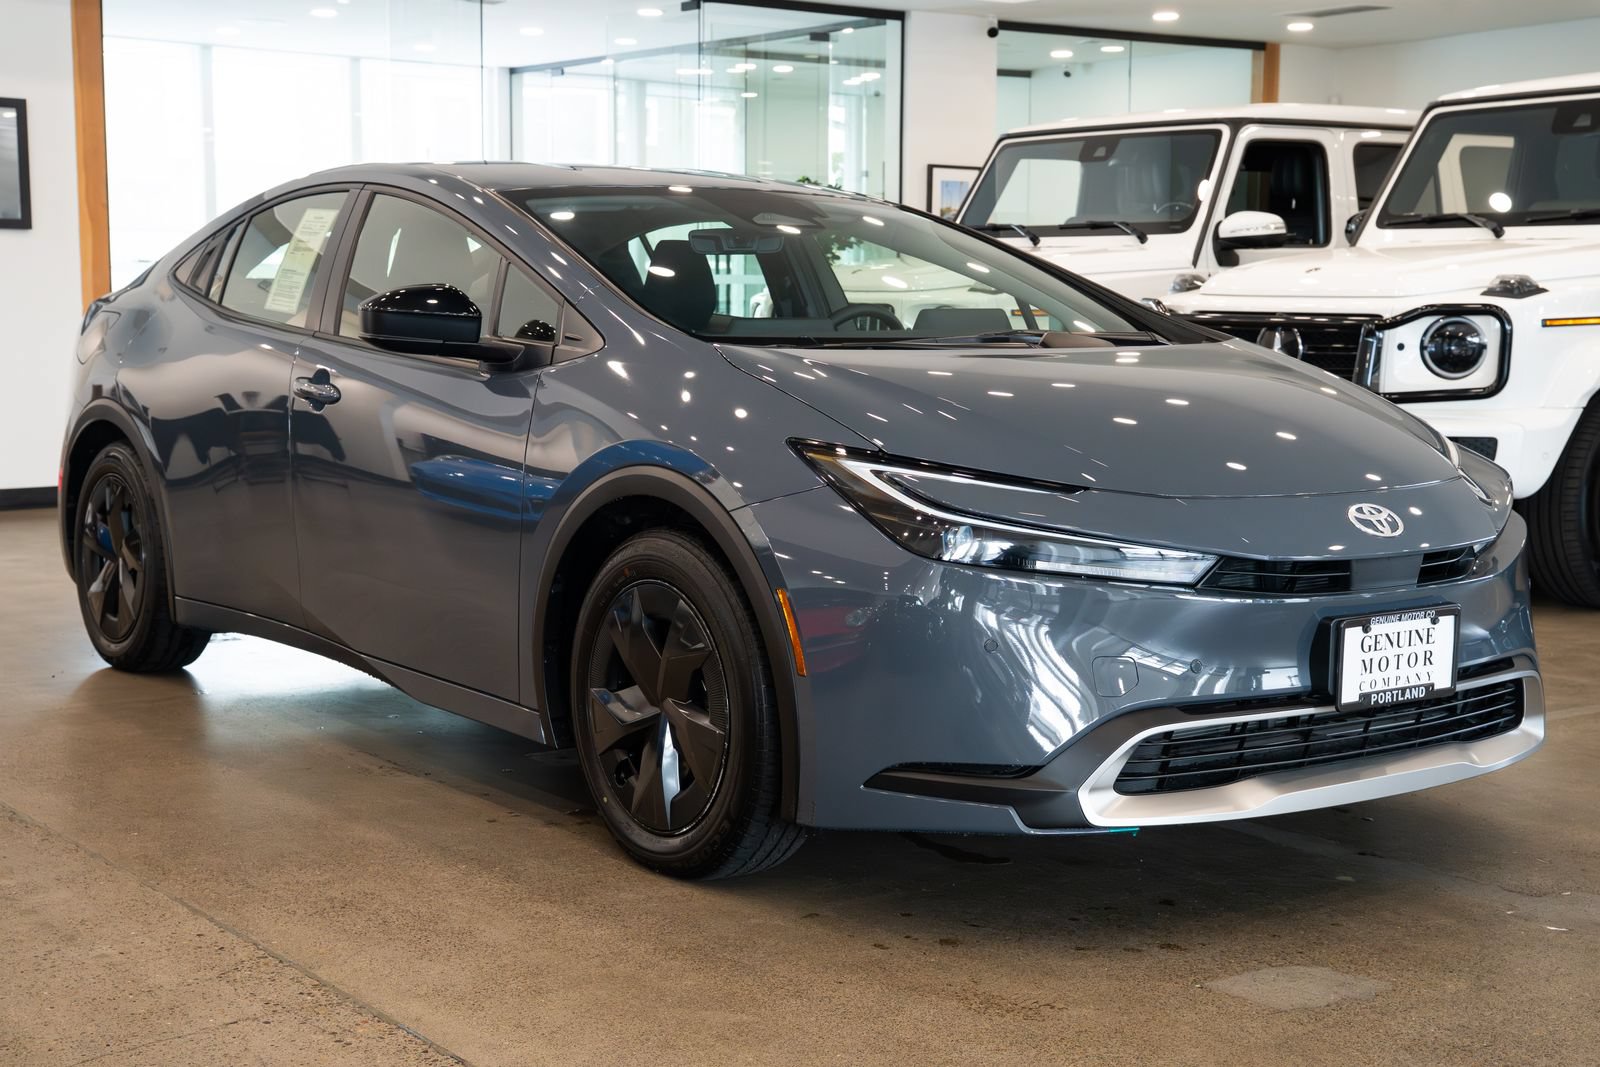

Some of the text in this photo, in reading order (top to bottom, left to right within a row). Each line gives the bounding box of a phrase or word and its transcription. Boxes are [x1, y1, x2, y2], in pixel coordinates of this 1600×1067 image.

[1370, 610, 1436, 625] GENUINE MOTOR CO
[1360, 627, 1436, 653] GENUINE
[1360, 650, 1434, 675] MOTOR
[1359, 671, 1434, 691] COMPANY
[1371, 686, 1426, 705] PORTLAND
